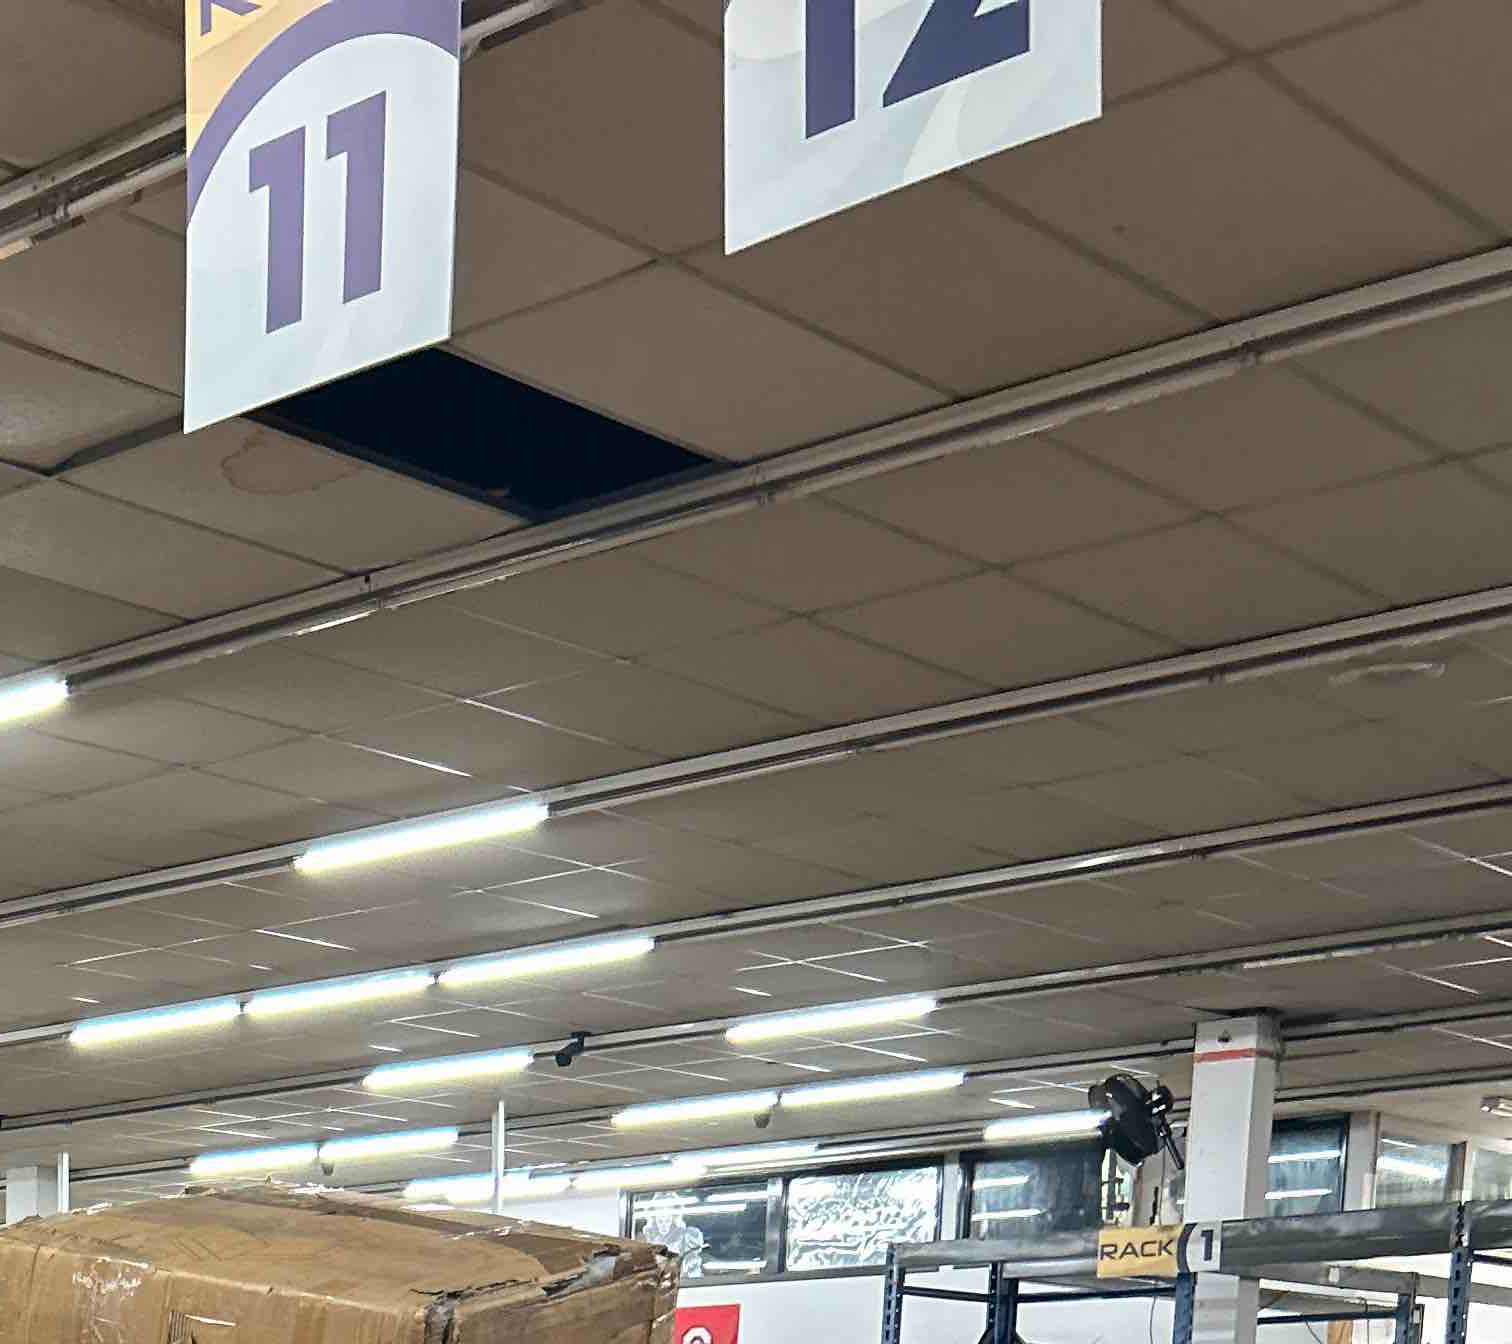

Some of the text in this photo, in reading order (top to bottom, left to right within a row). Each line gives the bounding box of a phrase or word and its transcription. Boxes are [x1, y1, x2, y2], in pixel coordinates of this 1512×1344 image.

[249, 89, 387, 335] 11
[1099, 1239, 1175, 1261] RACK
[1200, 1229, 1214, 1262] 1
